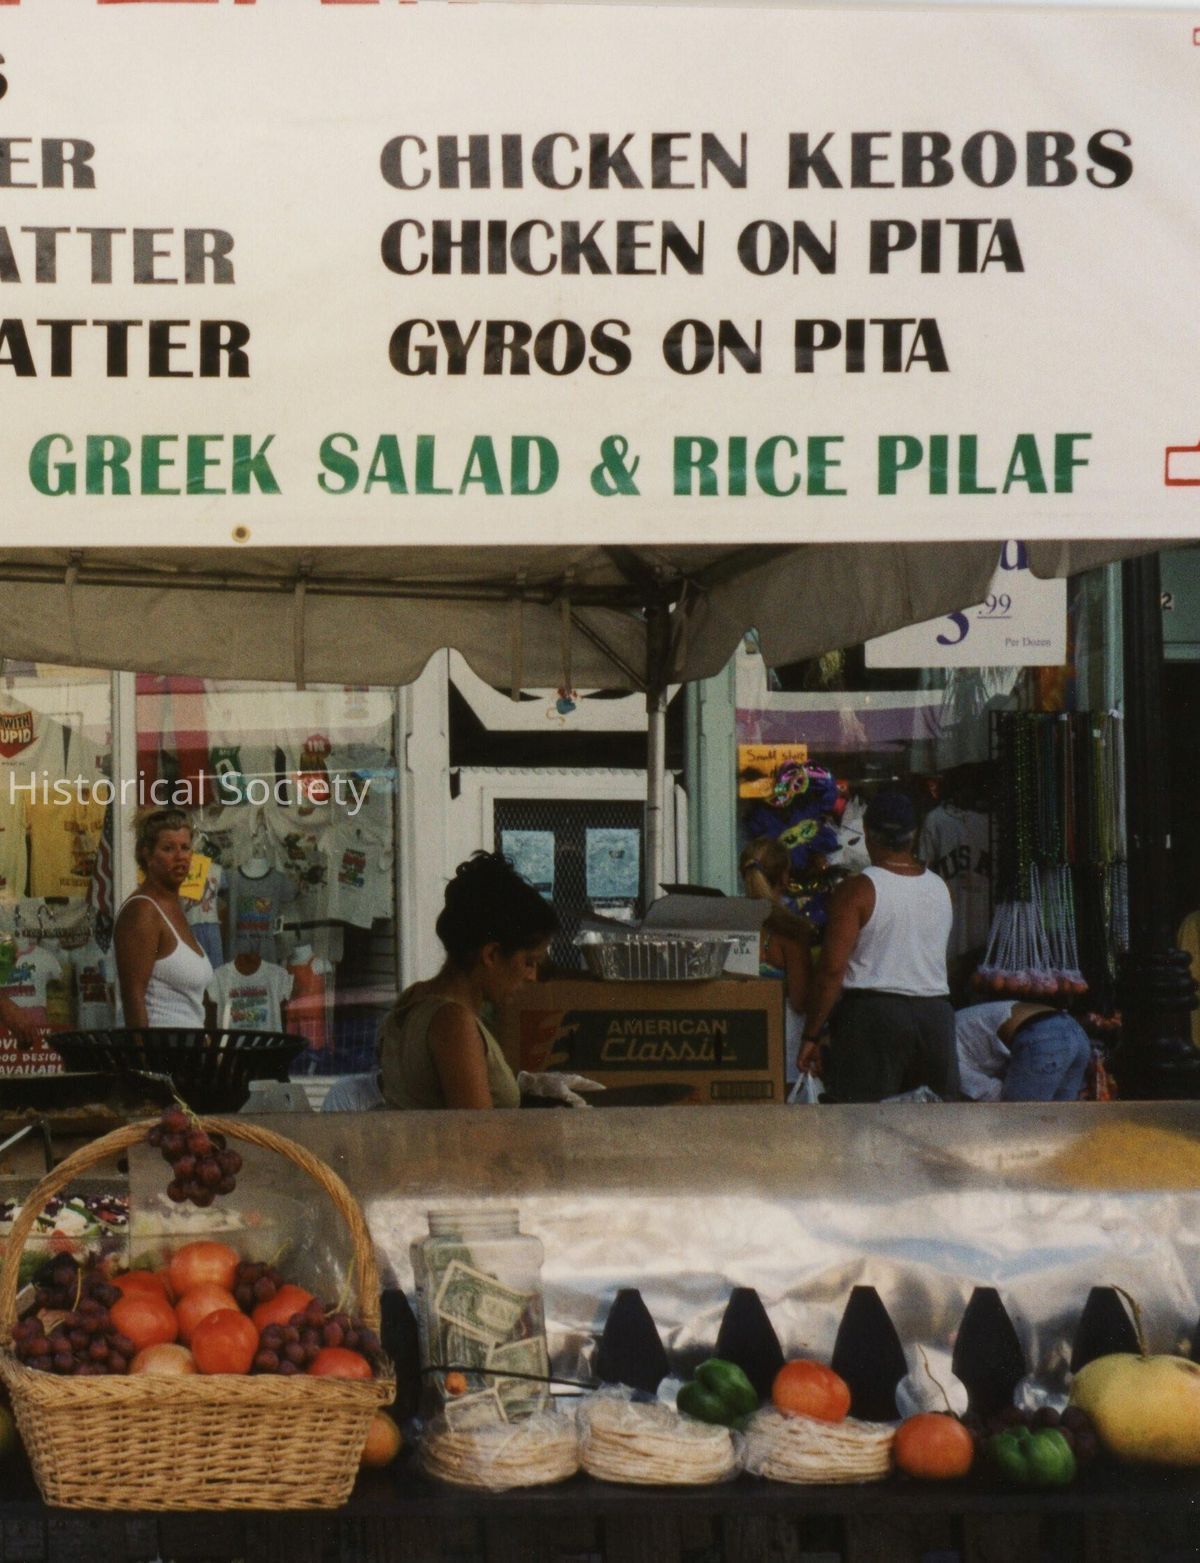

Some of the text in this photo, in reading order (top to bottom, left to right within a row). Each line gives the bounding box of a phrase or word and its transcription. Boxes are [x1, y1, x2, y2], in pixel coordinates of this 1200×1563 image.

[380, 129, 1133, 190] CHICKEN KEBOBS
[380, 218, 1025, 276] CHICKEN ON PITA
[388, 318, 950, 377] GYROS ON PITA
[29, 434, 280, 496] GREEK
[317, 433, 559, 495] SALAD
[590, 435, 640, 496] &
[673, 435, 847, 497] RICE
[878, 432, 1092, 495] PILAF
[5, 711, 31, 728] WITH
[607, 1018, 728, 1036] AMERICAN
